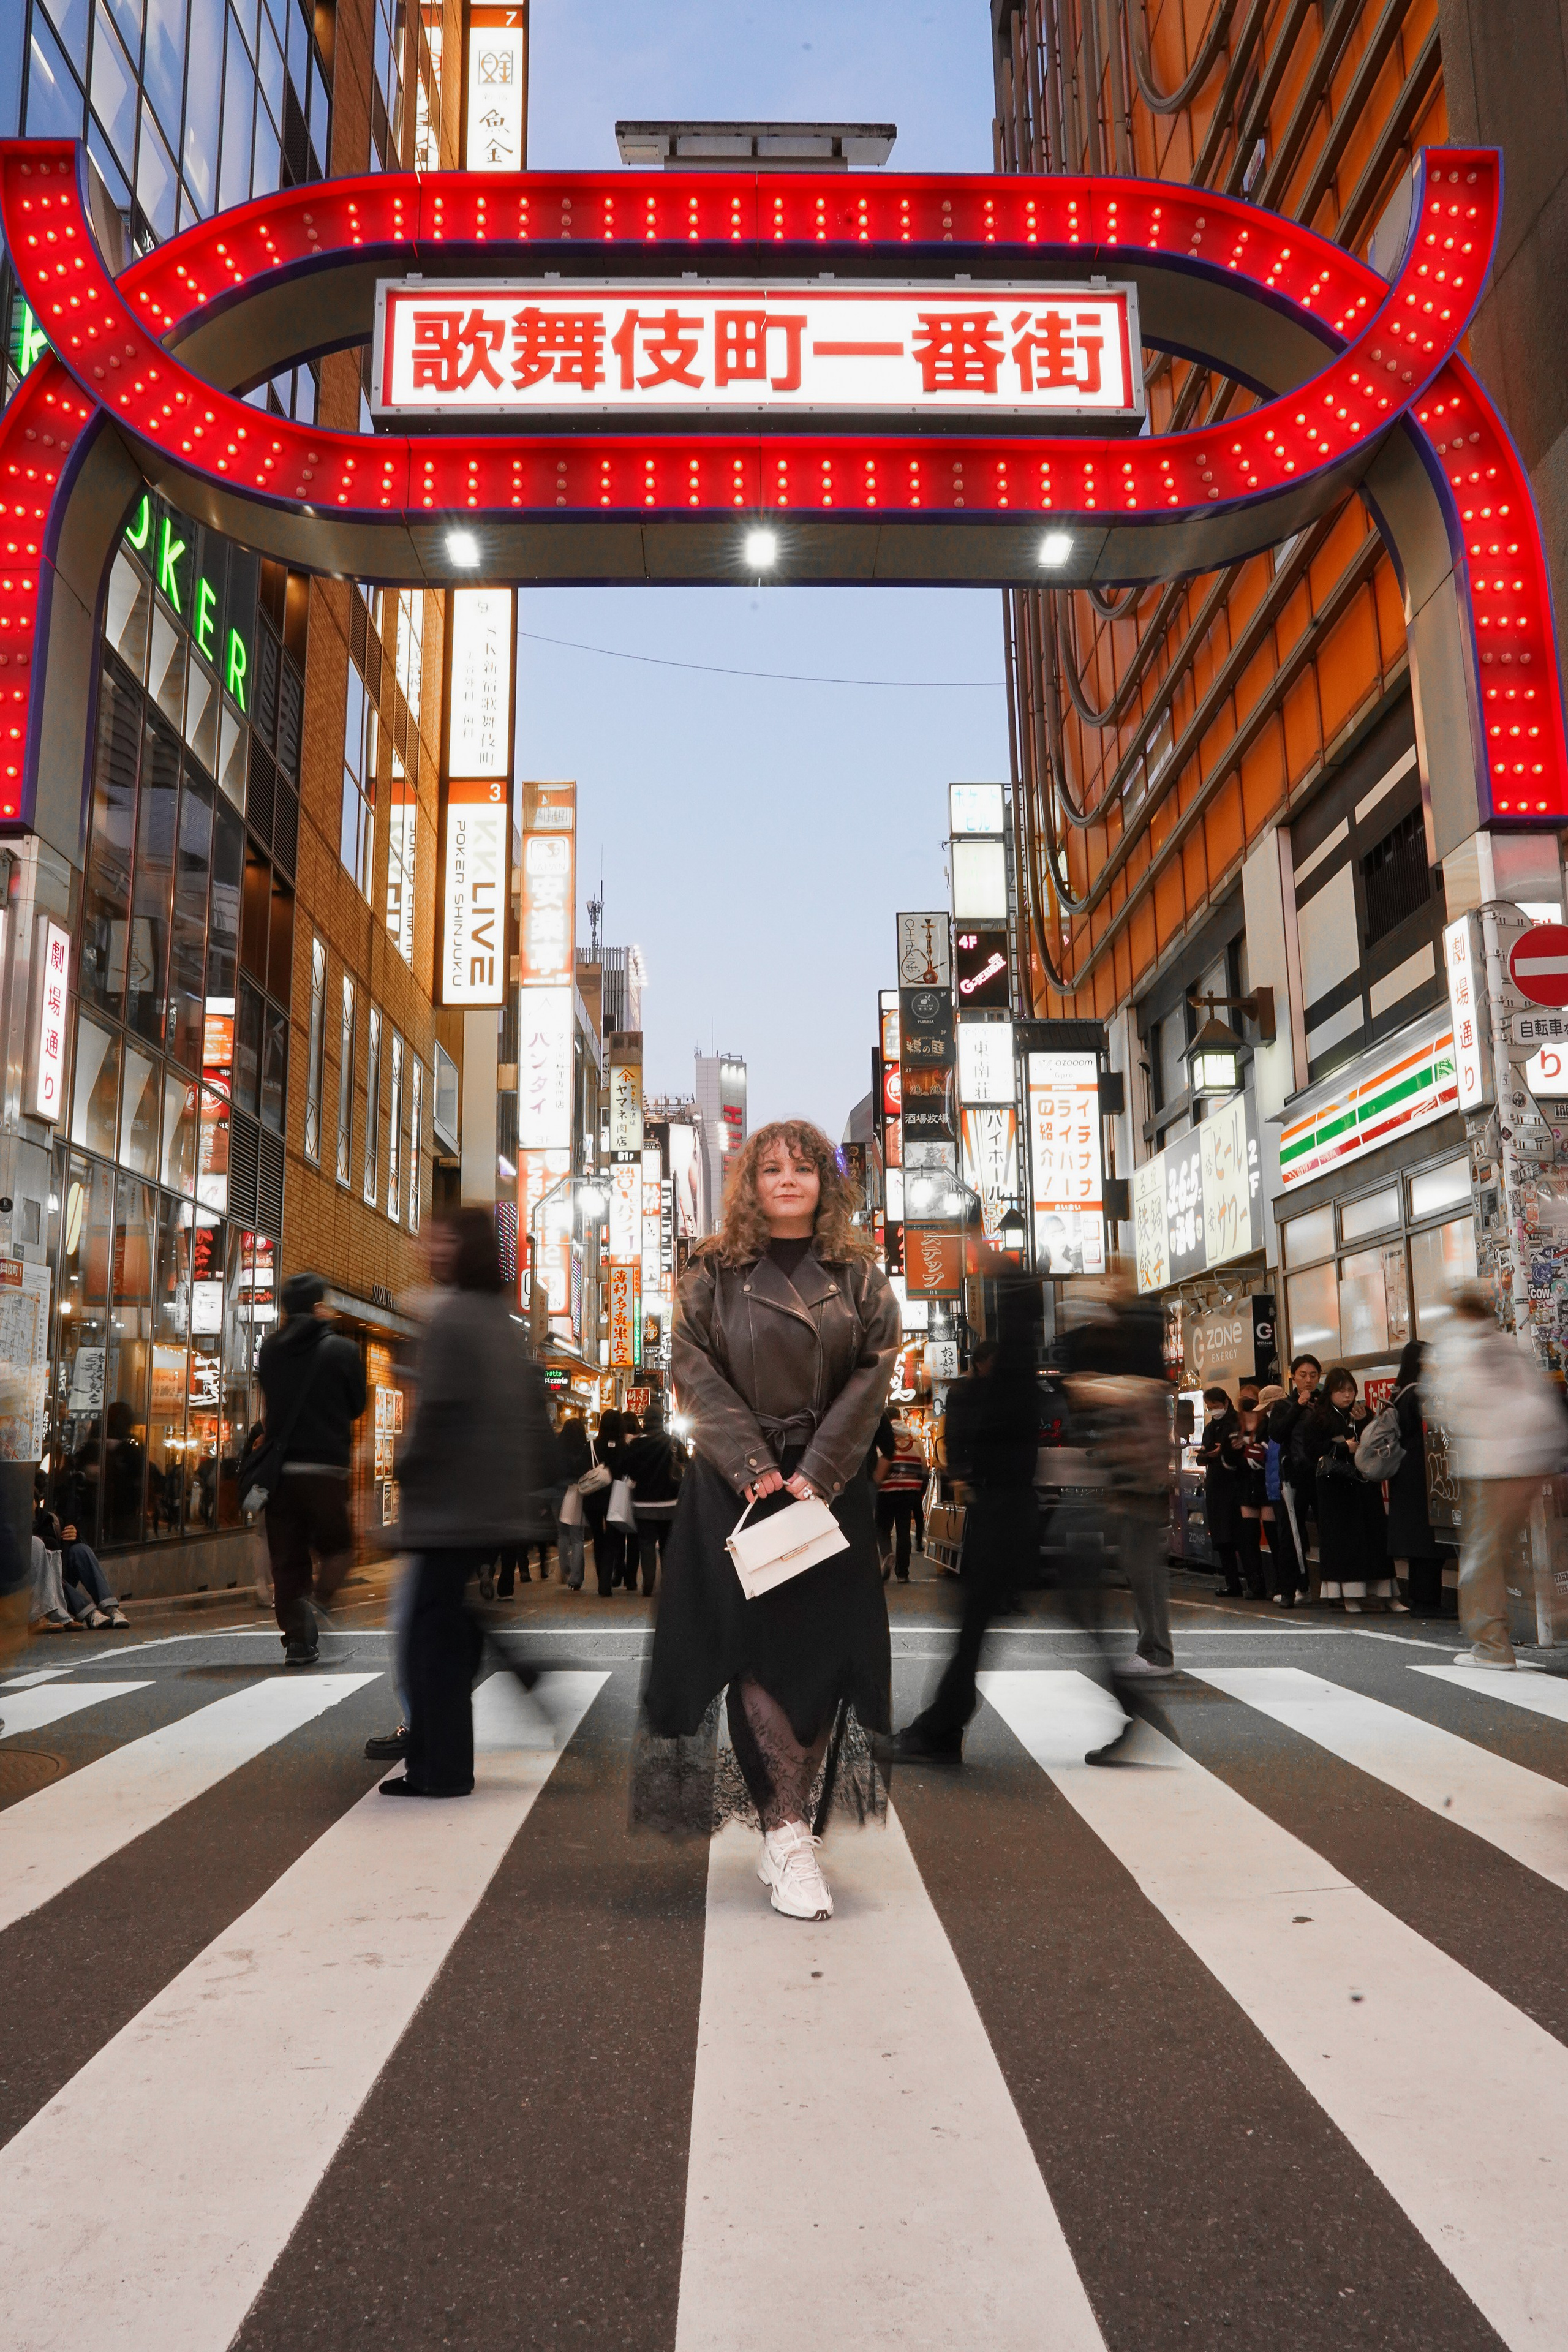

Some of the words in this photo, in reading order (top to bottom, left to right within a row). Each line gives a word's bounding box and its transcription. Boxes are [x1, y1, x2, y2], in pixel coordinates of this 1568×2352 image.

[505, 11, 518, 26] 7
[479, 109, 513, 163] 魚金
[411, 306, 1105, 393] 歌舞伎町一番街
[489, 783, 501, 801] 3
[455, 821, 466, 884] POKER
[452, 893, 464, 987] SHINJUKU
[958, 935, 978, 949] 4F
[44, 940, 64, 1100] 劇場通り
[1452, 932, 1475, 1092] 劇場通り
[616, 1085, 628, 1147] ヤマネ肉店
[905, 1113, 950, 1125] 酒場牧場
[617, 1152, 634, 1161] B1F
[987, 1115, 1003, 1200] ハイボール
[1058, 1099, 1073, 1196] ライバー
[1076, 1099, 1093, 1196] イチナナ
[921, 1232, 944, 1288] ステップ
[373, 1283, 393, 1309] SUZUYA
[1530, 1288, 1550, 1300] COW
[1212, 1348, 1238, 1363] ENERGY
